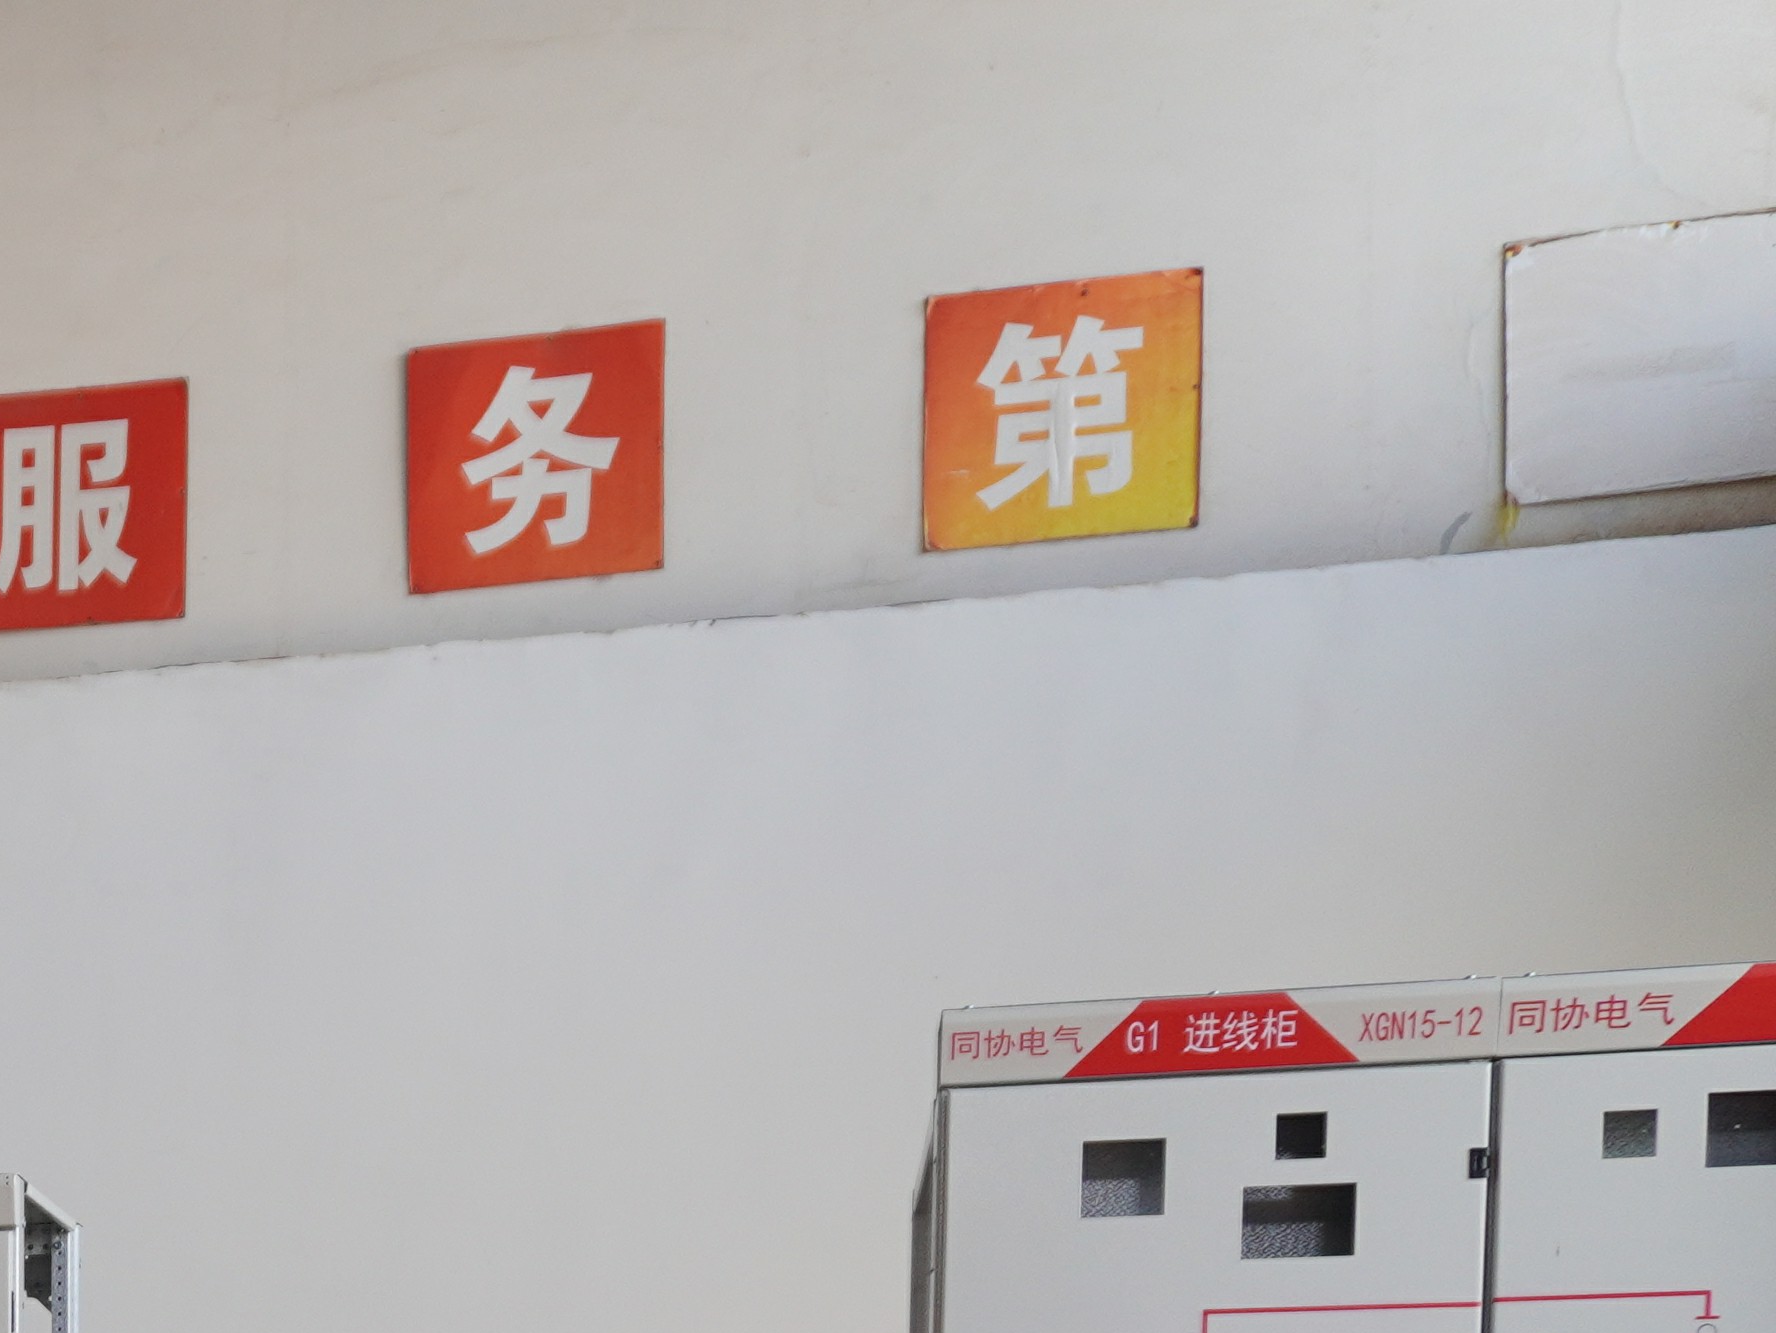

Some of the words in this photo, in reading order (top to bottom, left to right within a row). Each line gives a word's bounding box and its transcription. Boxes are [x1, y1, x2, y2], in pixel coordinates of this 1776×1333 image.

[1126, 1020, 1160, 1054] G1
[1182, 1007, 1300, 1056] 进线柜
[1359, 1006, 1484, 1043] XGN15-12
[1506, 992, 1677, 1038] 同协电气
[950, 1025, 1085, 1060] 同协电气
